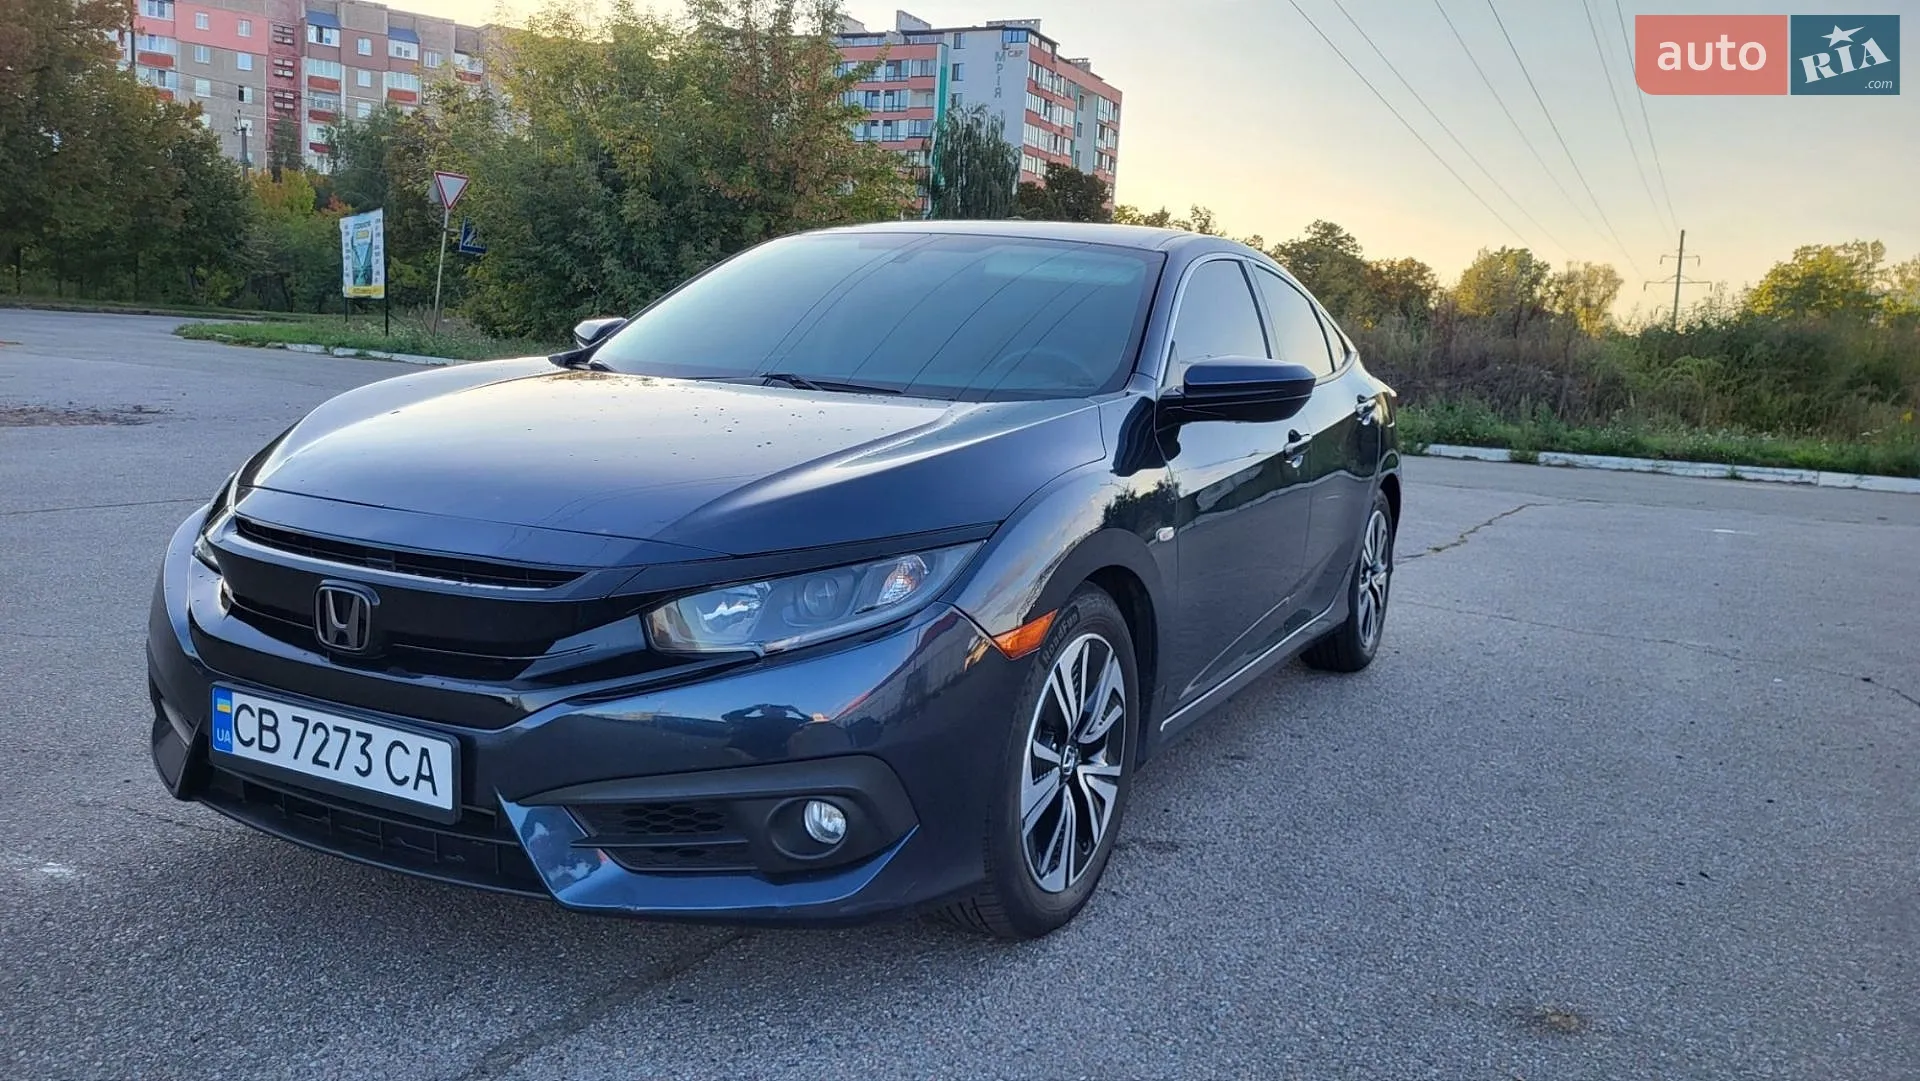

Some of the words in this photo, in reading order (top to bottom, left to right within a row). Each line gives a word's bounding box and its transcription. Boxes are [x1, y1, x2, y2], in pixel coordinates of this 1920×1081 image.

[994, 51, 1007, 98] МРІЯ
[216, 727, 232, 744] UA
[233, 703, 281, 754] CB
[291, 715, 373, 777] 7273
[385, 740, 438, 796] CA
